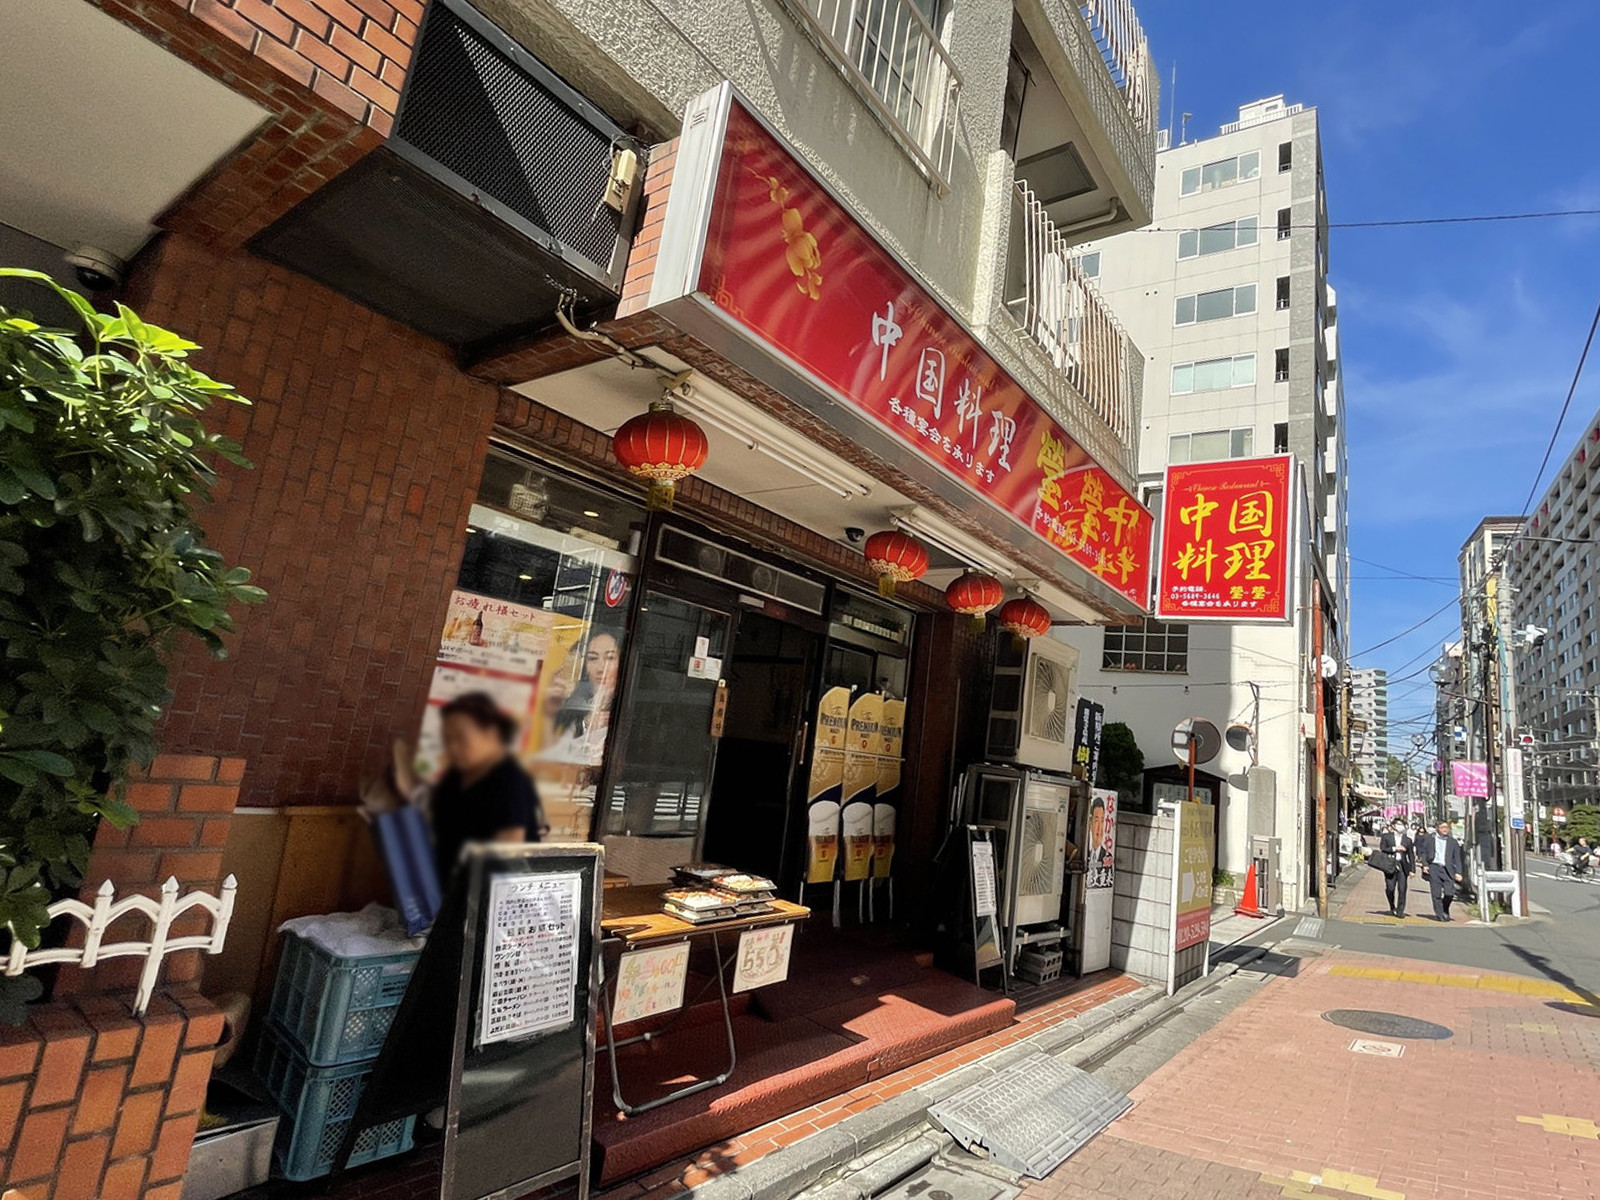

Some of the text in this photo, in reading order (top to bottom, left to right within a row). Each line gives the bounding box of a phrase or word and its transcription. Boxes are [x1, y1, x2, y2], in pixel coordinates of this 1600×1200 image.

[872, 301, 1016, 472] 中国料理
[888, 397, 995, 483] 各種宴会を承ります
[1180, 491, 1273, 541] 中国
[1172, 539, 1275, 583] 料理
[454, 594, 536, 621] お疲れ様セット
